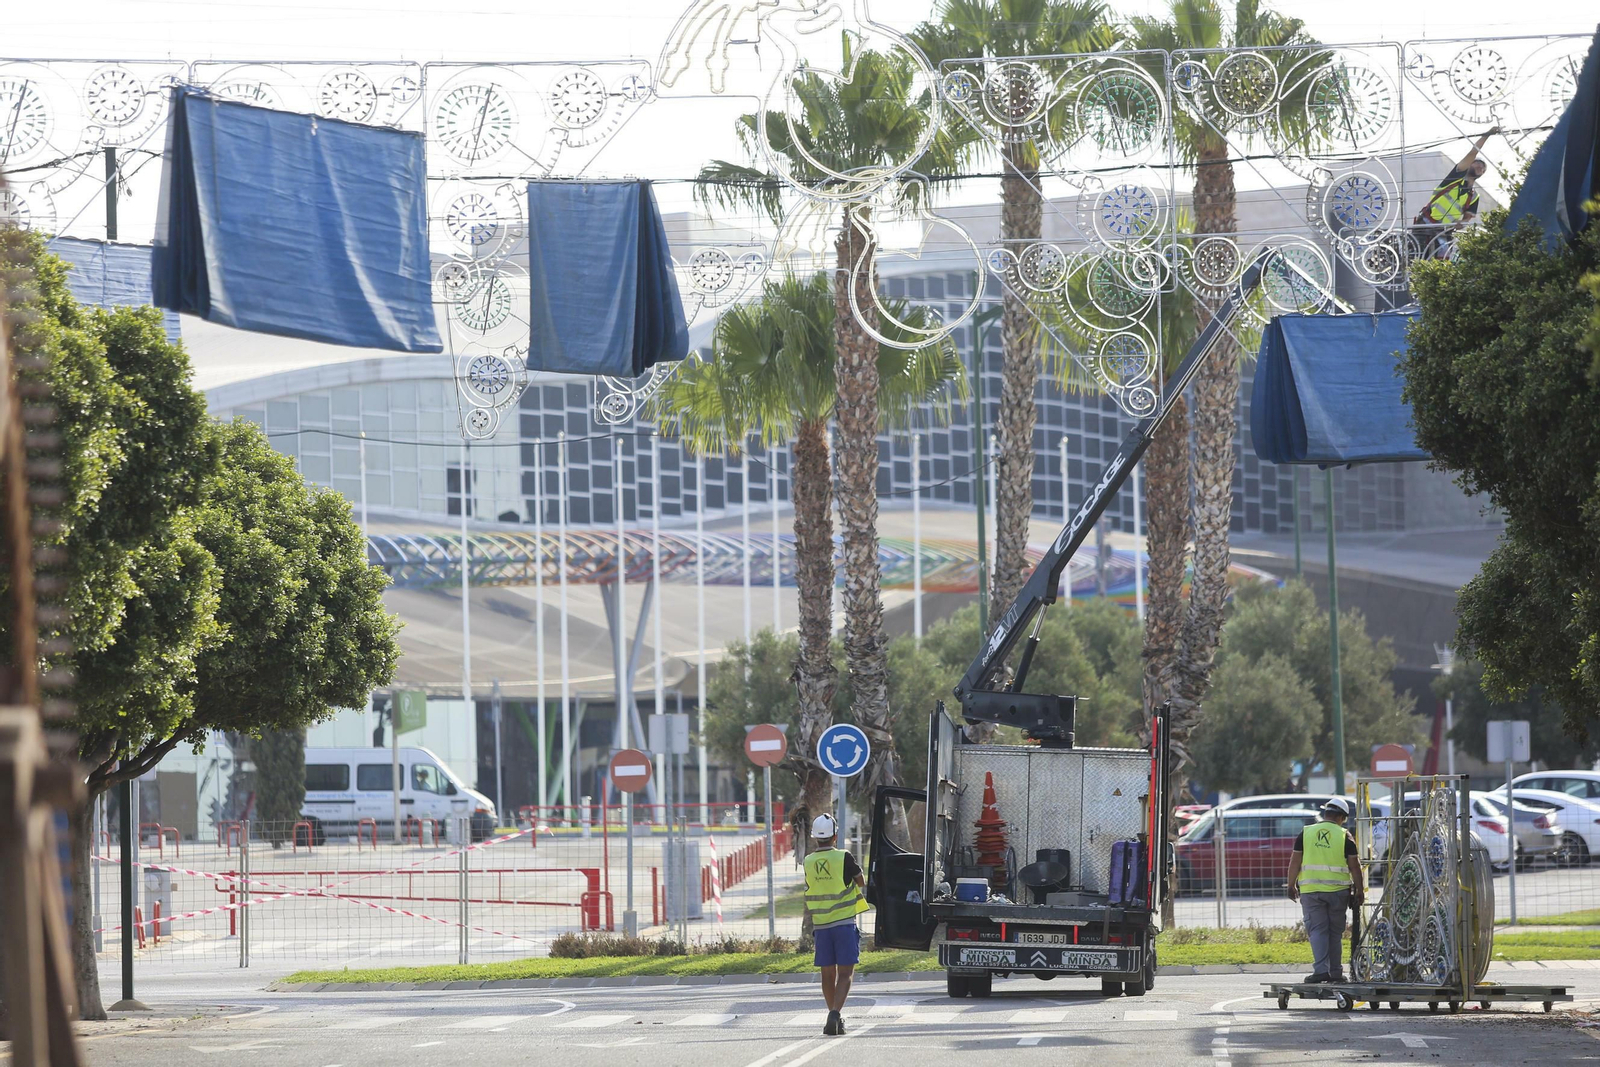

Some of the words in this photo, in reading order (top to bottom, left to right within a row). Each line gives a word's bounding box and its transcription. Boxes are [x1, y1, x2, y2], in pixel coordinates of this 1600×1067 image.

[1054, 452, 1126, 555] SOCAGE
[1022, 933, 1044, 943] 1639
[1048, 934, 1065, 944] JDJ
[966, 954, 1010, 963] MINDA
[1068, 957, 1112, 966] MINDA
